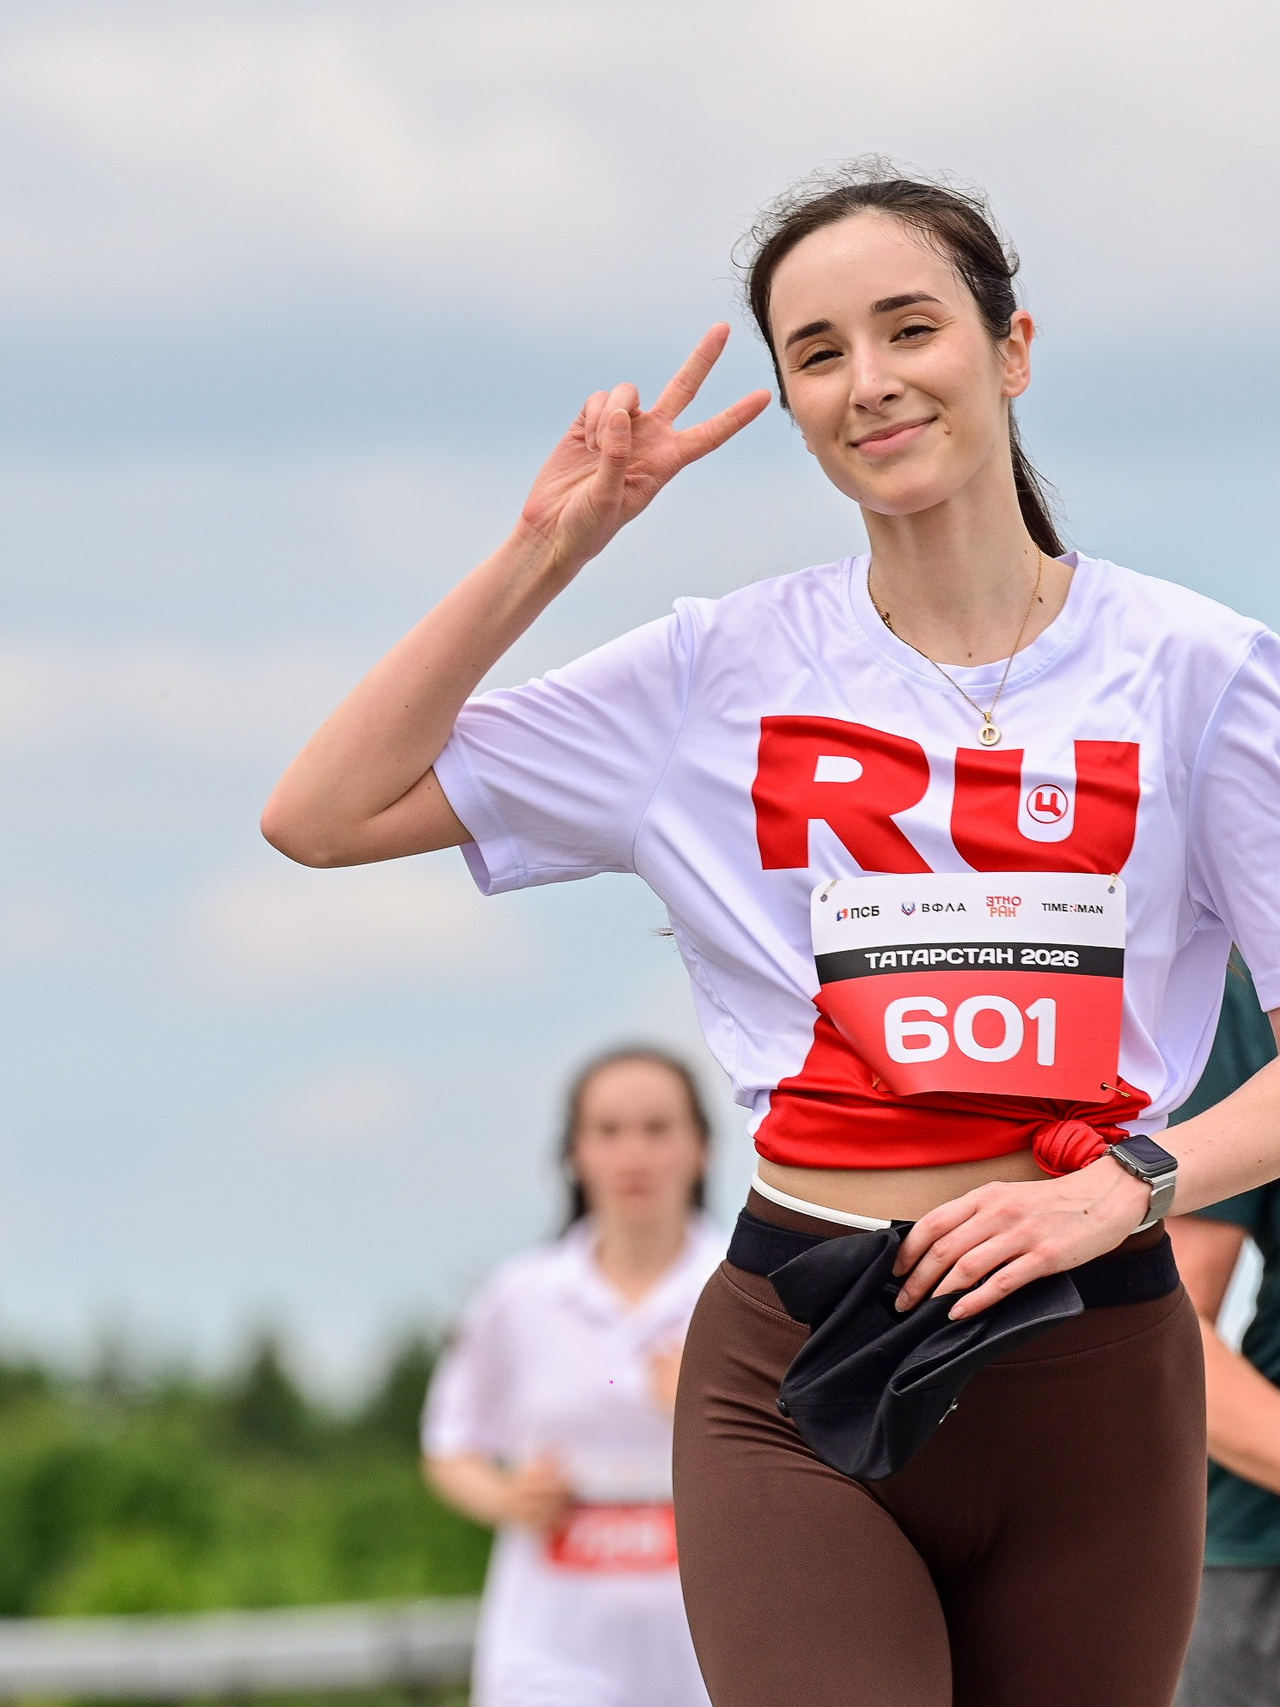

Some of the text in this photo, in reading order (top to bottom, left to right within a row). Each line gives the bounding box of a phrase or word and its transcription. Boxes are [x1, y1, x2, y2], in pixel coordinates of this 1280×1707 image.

[985, 896, 1022, 907] ЭТНО
[850, 905, 880, 919] ПСБ
[989, 905, 1017, 917] РАН
[864, 948, 1080, 969] ТАТАРСТАН 2026
[883, 994, 1057, 1067] 601
